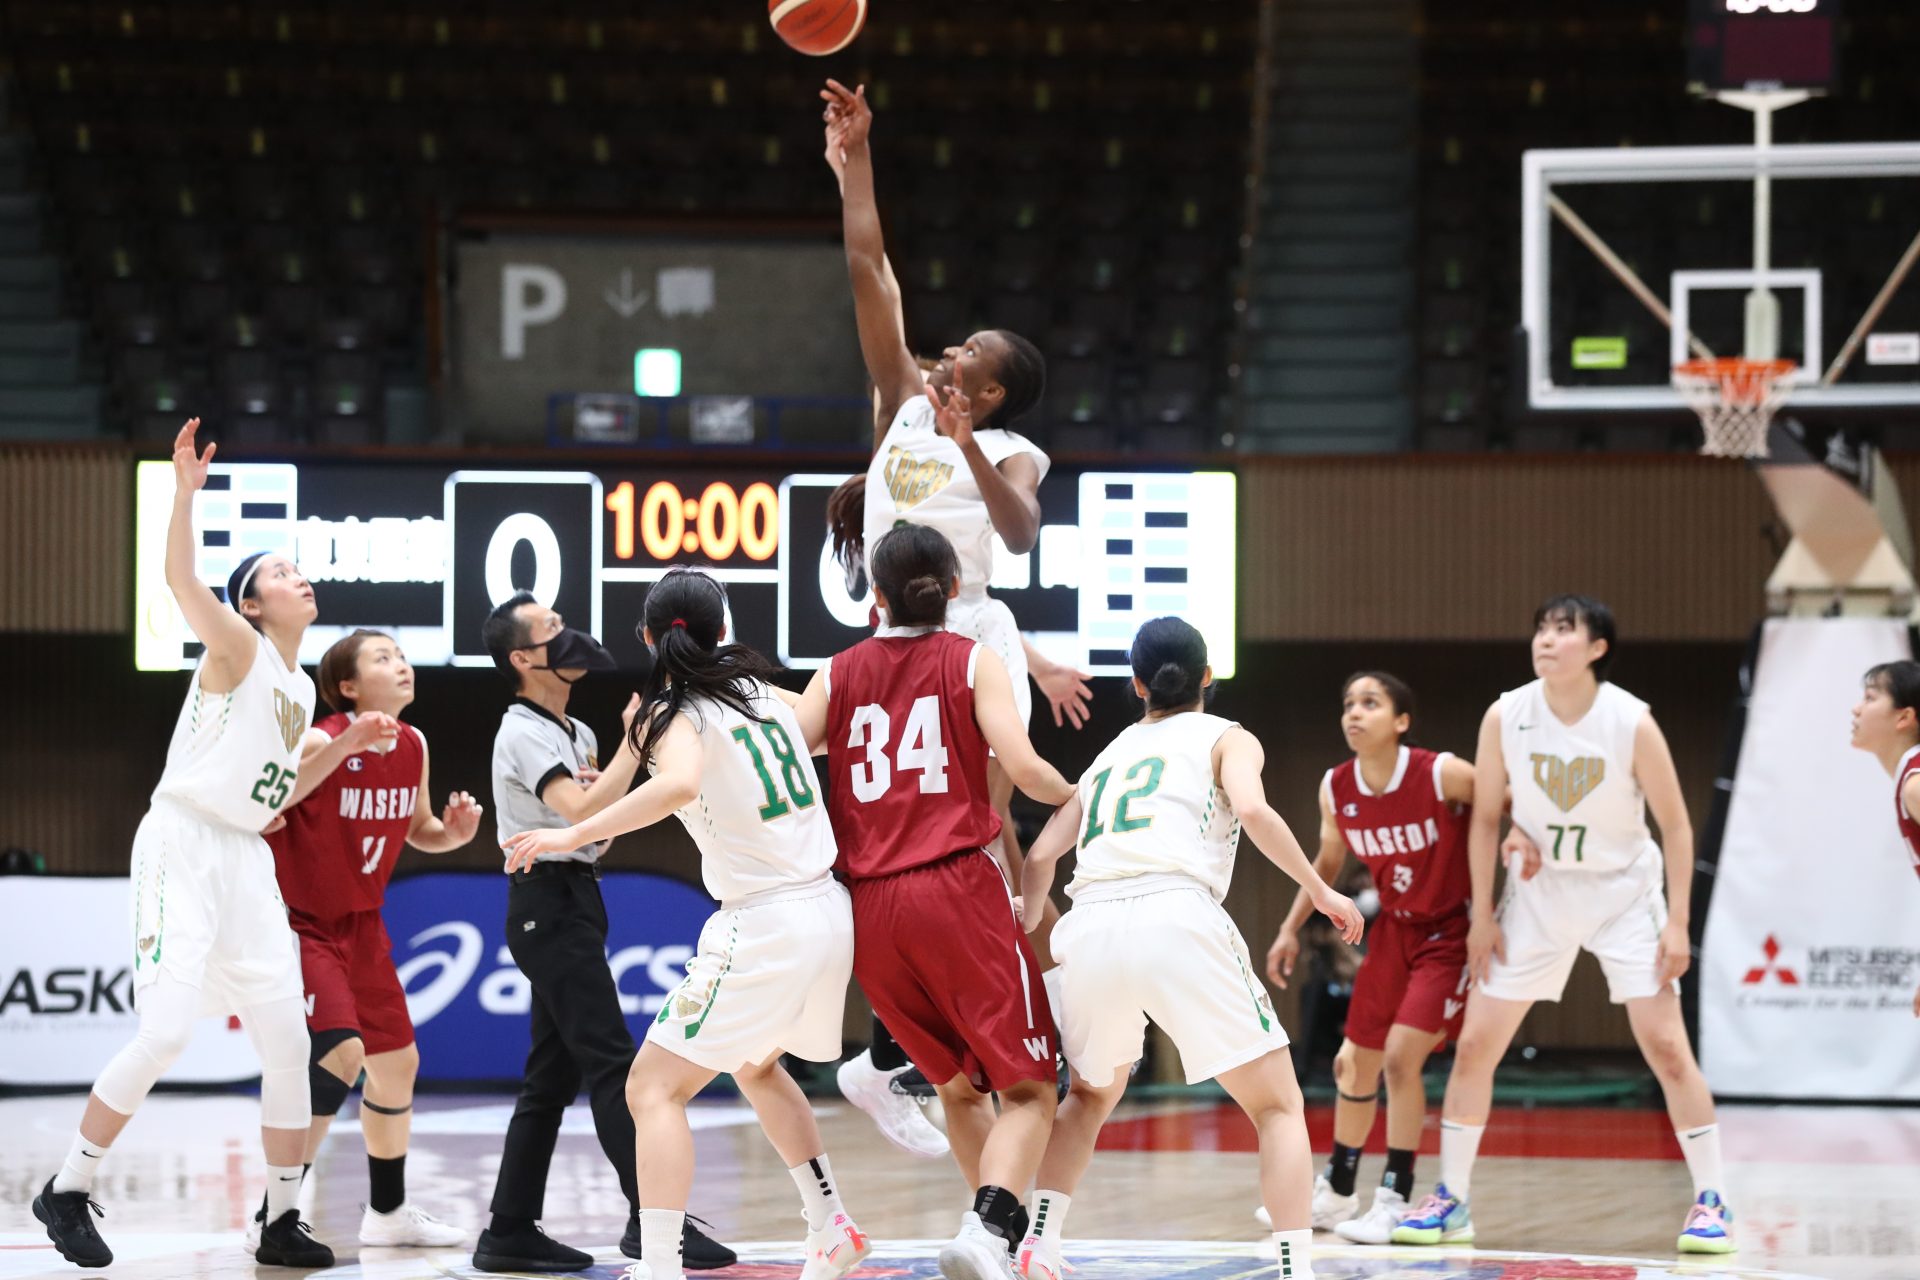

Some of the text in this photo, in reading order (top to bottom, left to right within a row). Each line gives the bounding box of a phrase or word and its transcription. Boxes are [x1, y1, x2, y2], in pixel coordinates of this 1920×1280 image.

[502, 263, 567, 360] P
[606, 480, 778, 561] 10:00
[484, 512, 562, 611] 0
[731, 716, 817, 823] 18
[848, 695, 949, 803] 34
[250, 761, 298, 811] 25
[1082, 756, 1168, 850] 12
[1345, 817, 1441, 857] WASEDA
[1547, 824, 1588, 863] 77
[1392, 863, 1414, 894] 3
[0, 968, 135, 1014] ASK
[478, 945, 693, 1015] acs
[1022, 1035, 1050, 1062] W
